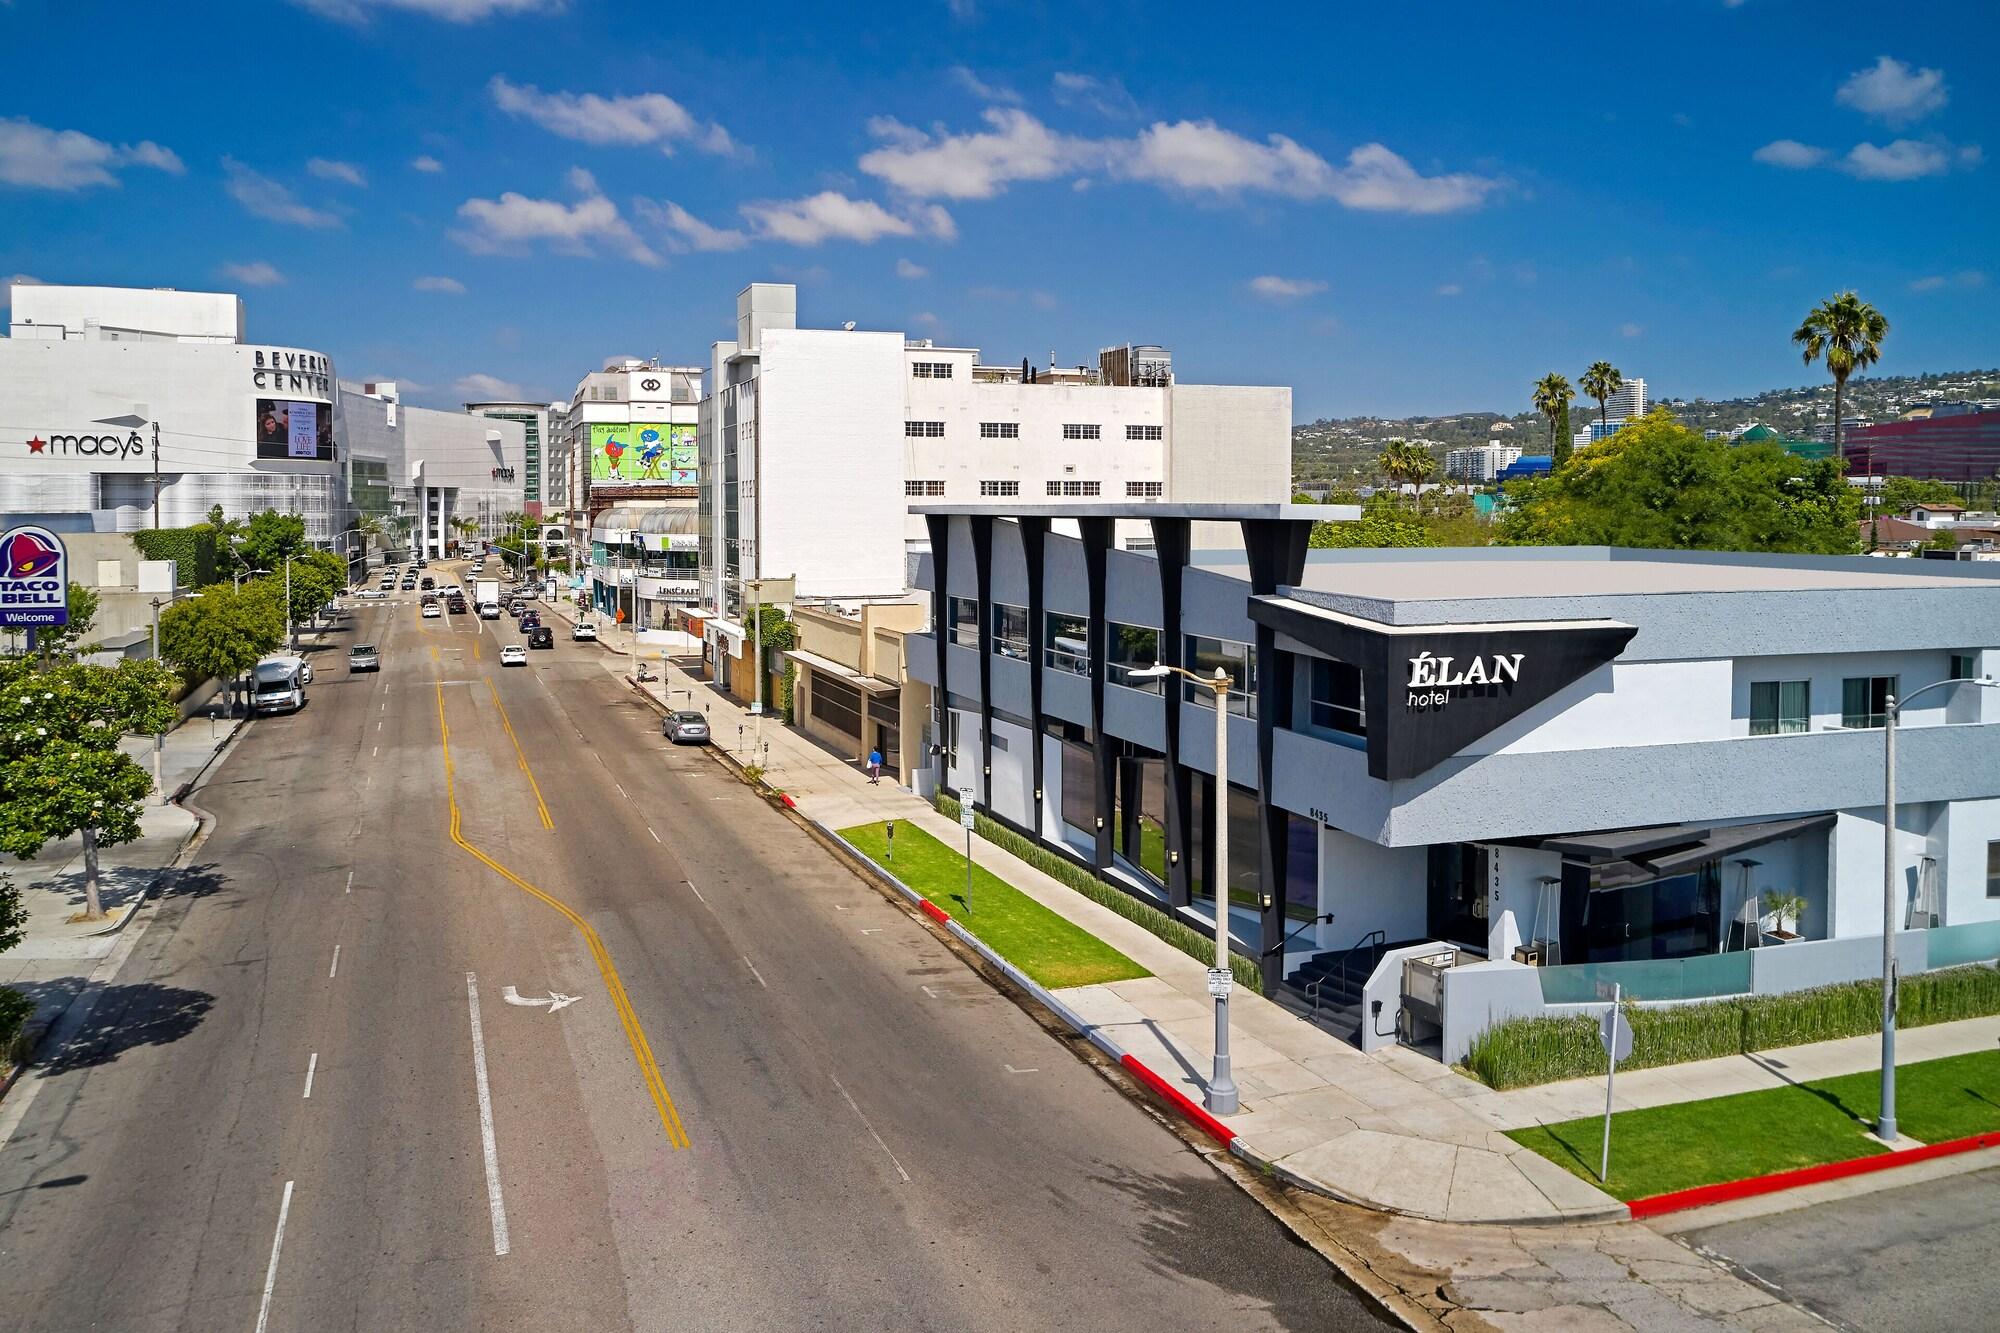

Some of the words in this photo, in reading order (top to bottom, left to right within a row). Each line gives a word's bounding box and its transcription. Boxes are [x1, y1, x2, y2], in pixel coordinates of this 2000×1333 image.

[255, 351, 329, 370] BEVERLY
[254, 372, 329, 391] CENTER
[50, 430, 144, 460] macy's
[0, 581, 60, 591] TACO
[2, 594, 61, 603] BELL
[6, 613, 55, 622] Welcome
[1407, 651, 1525, 687] ÉLAN
[1407, 689, 1450, 706] hotel
[1310, 807, 1328, 822] 8435
